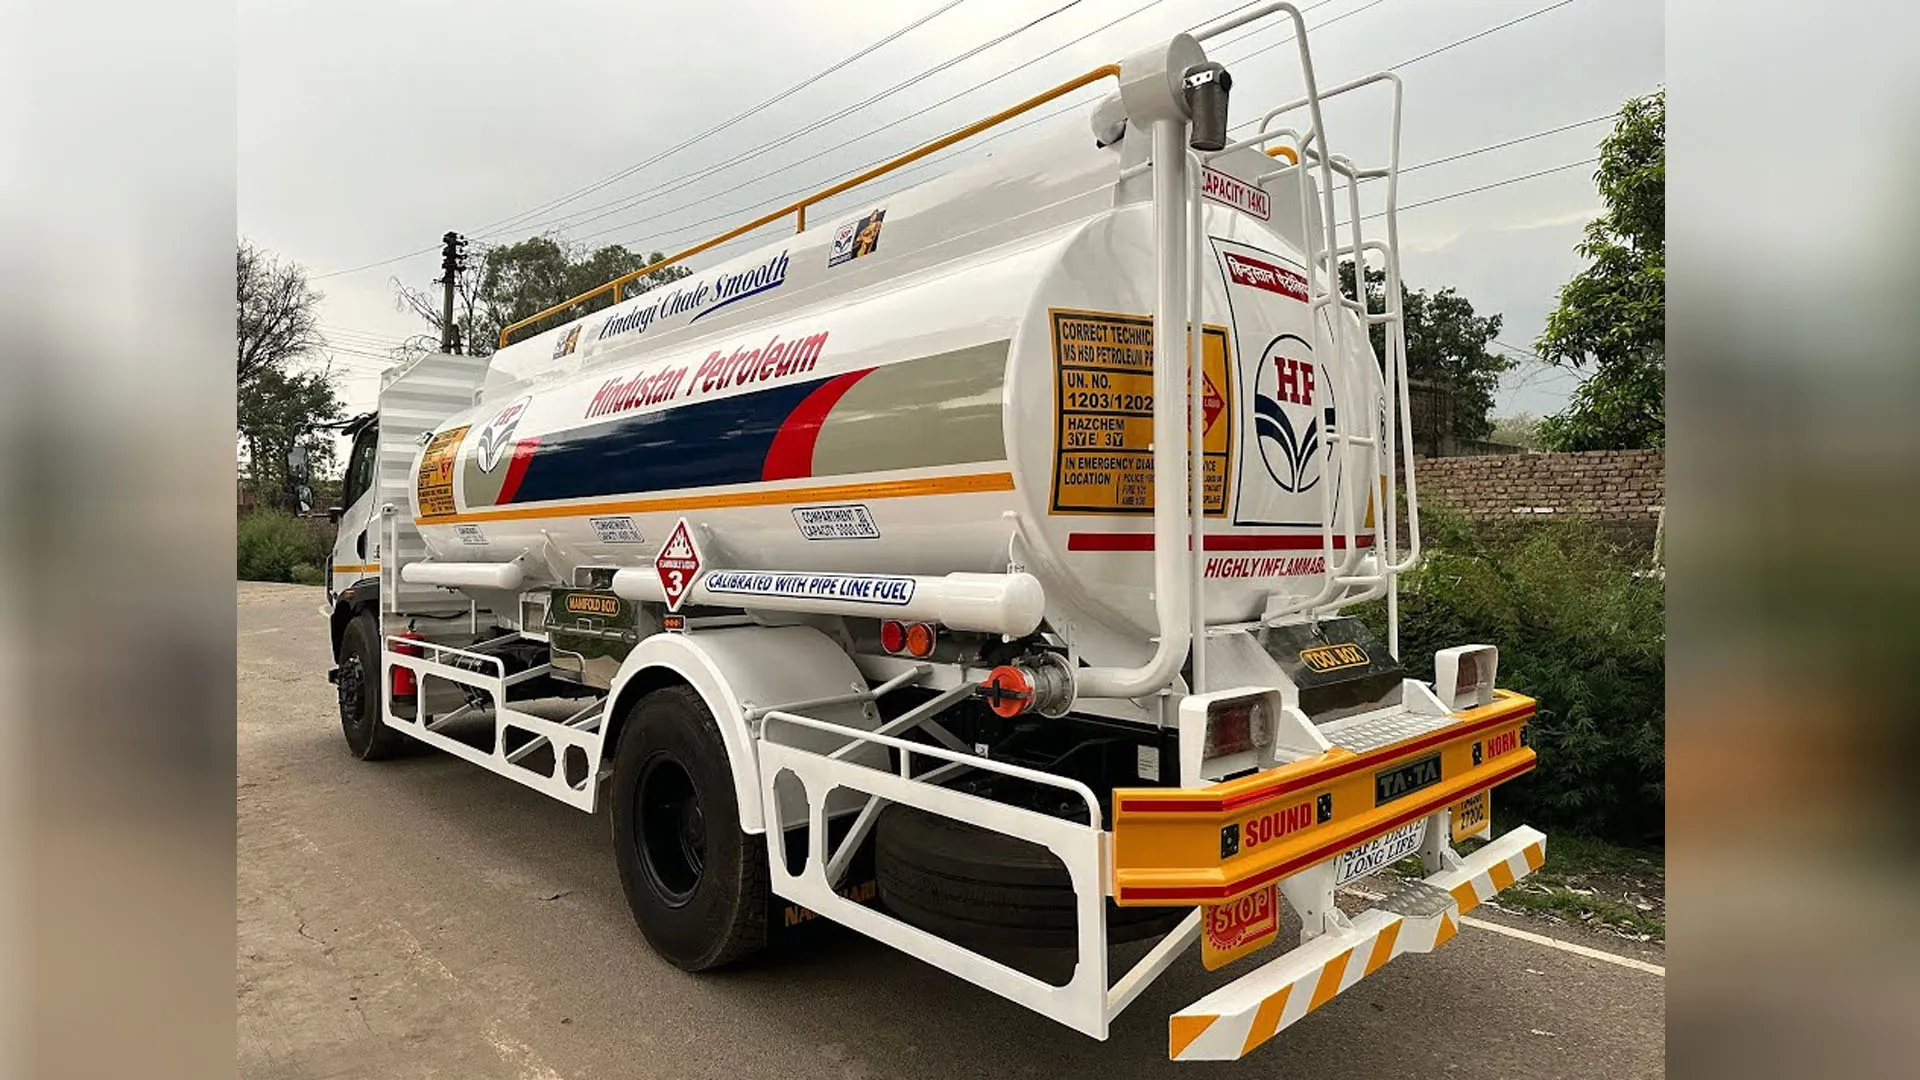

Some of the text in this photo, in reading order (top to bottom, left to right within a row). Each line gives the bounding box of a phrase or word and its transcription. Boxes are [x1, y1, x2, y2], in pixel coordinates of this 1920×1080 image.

[1247, 190, 1266, 215] 14KL
[599, 249, 790, 341] Zindagi Chale Smooth
[1062, 321, 1154, 346] CORRECT TECHNIC
[1078, 344, 1095, 362] HSD
[1096, 346, 1143, 365] PETROLEUM
[584, 331, 829, 419] Hindustan Petroleum
[1067, 372, 1112, 389] UN. NO.
[1274, 356, 1315, 406] HP
[1068, 392, 1154, 411] 1203/1202
[1068, 417, 1125, 430] HAZCHEM
[1065, 457, 1076, 470] IN
[1078, 457, 1134, 470] EMERGENCY
[1064, 472, 1111, 485] LOCATION
[802, 509, 855, 524] COMPARTMENT
[1204, 556, 1325, 577] HIGHLY INFLAMMAB
[666, 570, 683, 596] 3
[708, 573, 907, 600] CALIBRATED WITH PIPE LINE FUEL
[569, 596, 617, 613] MANIFOLD BOX
[1303, 646, 1365, 669] TOOL BOX
[1245, 802, 1312, 847] SOUND
[1344, 834, 1416, 879] LONG LIFE
[1215, 888, 1268, 933] STOP
